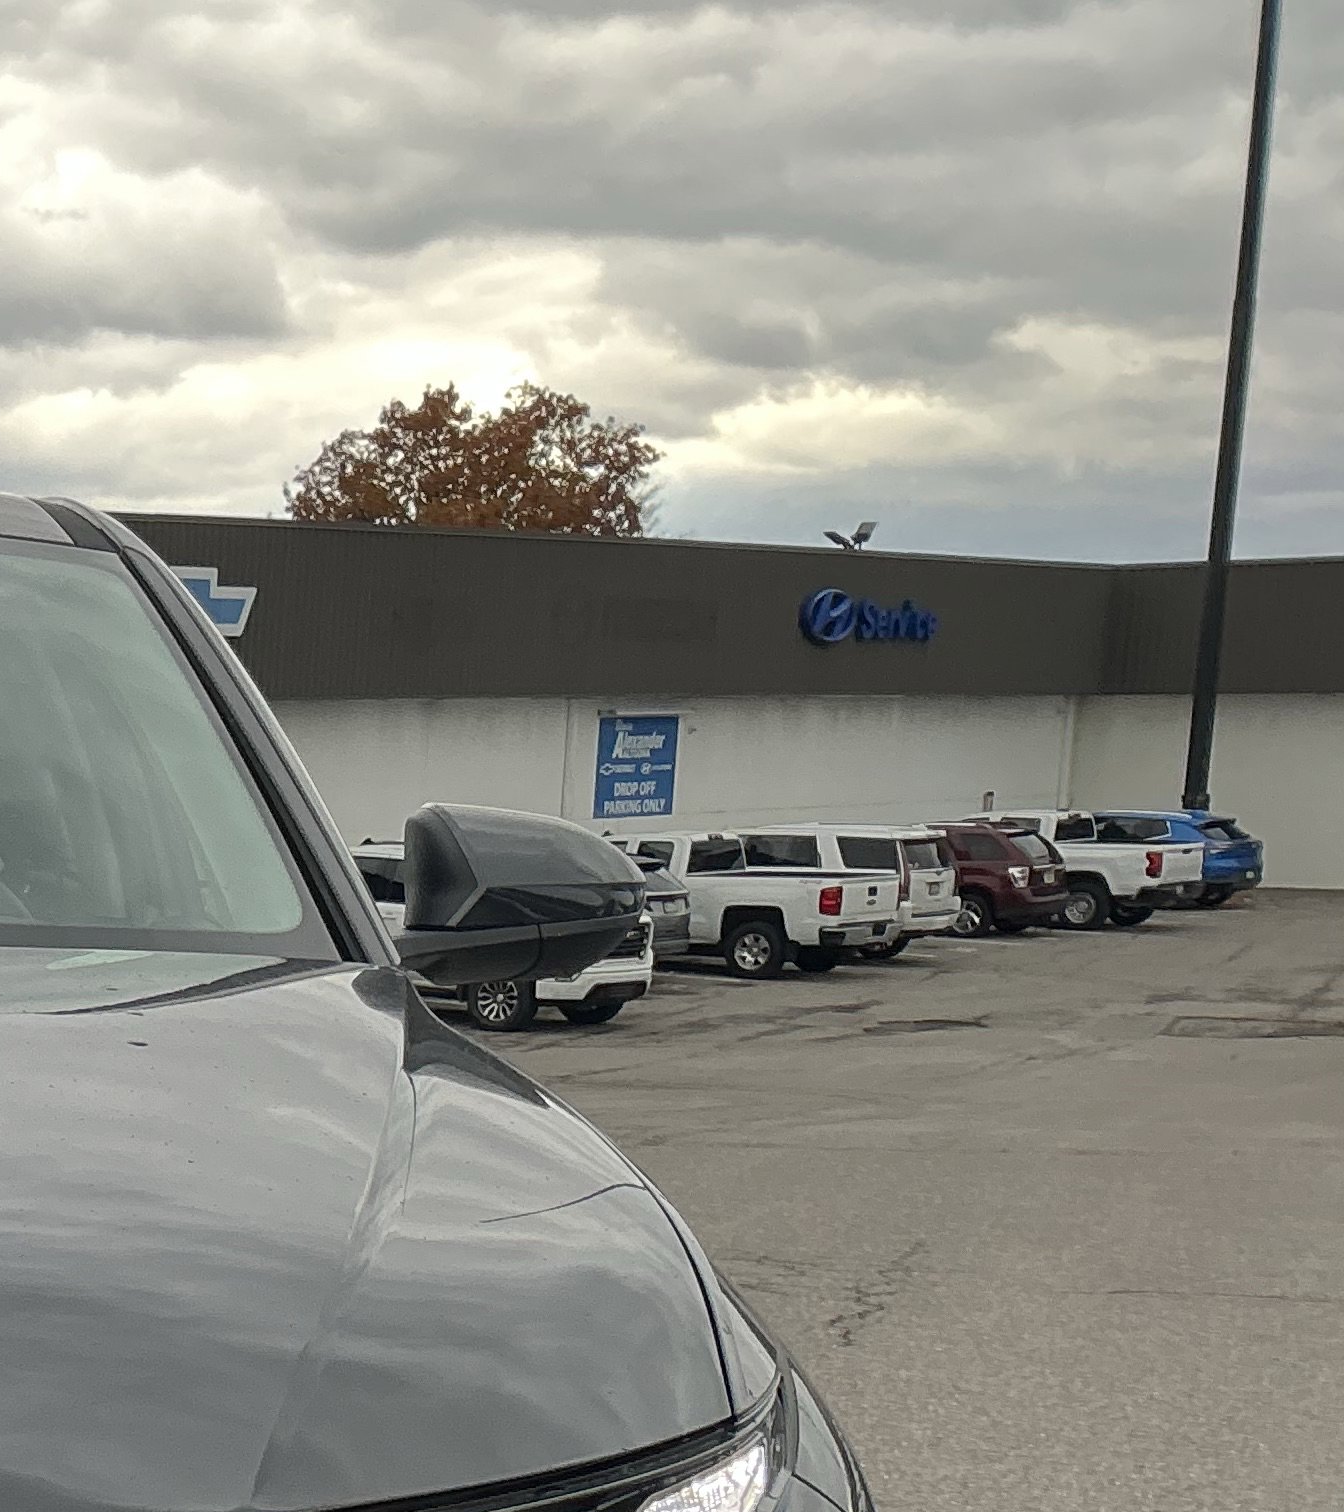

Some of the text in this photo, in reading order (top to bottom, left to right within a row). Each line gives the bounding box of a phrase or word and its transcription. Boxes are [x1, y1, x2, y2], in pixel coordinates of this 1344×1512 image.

[614, 780, 657, 797] DROP OFF
[603, 799, 666, 816] PARKING ONLY
